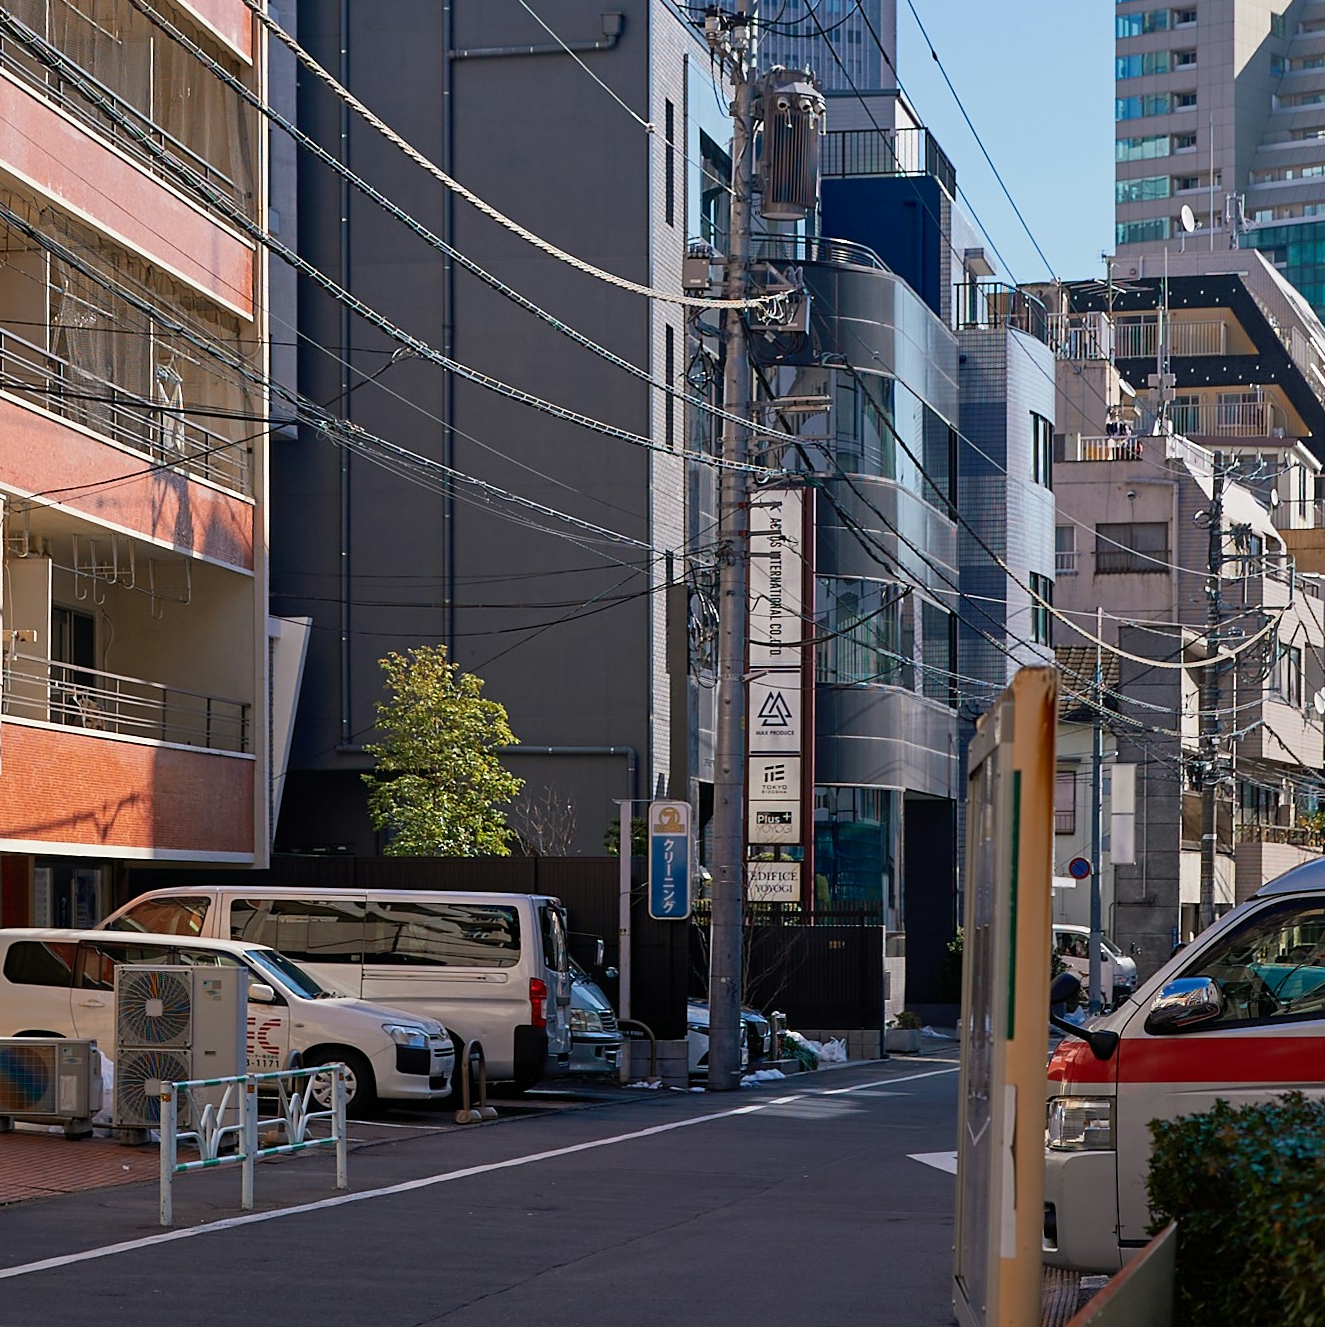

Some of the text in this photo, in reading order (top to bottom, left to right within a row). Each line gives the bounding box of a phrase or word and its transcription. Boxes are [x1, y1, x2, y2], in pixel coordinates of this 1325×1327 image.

[663, 838, 675, 914] クリーニング
[751, 871, 798, 881] EDIFICE
[755, 884, 793, 893] YOYOGI
